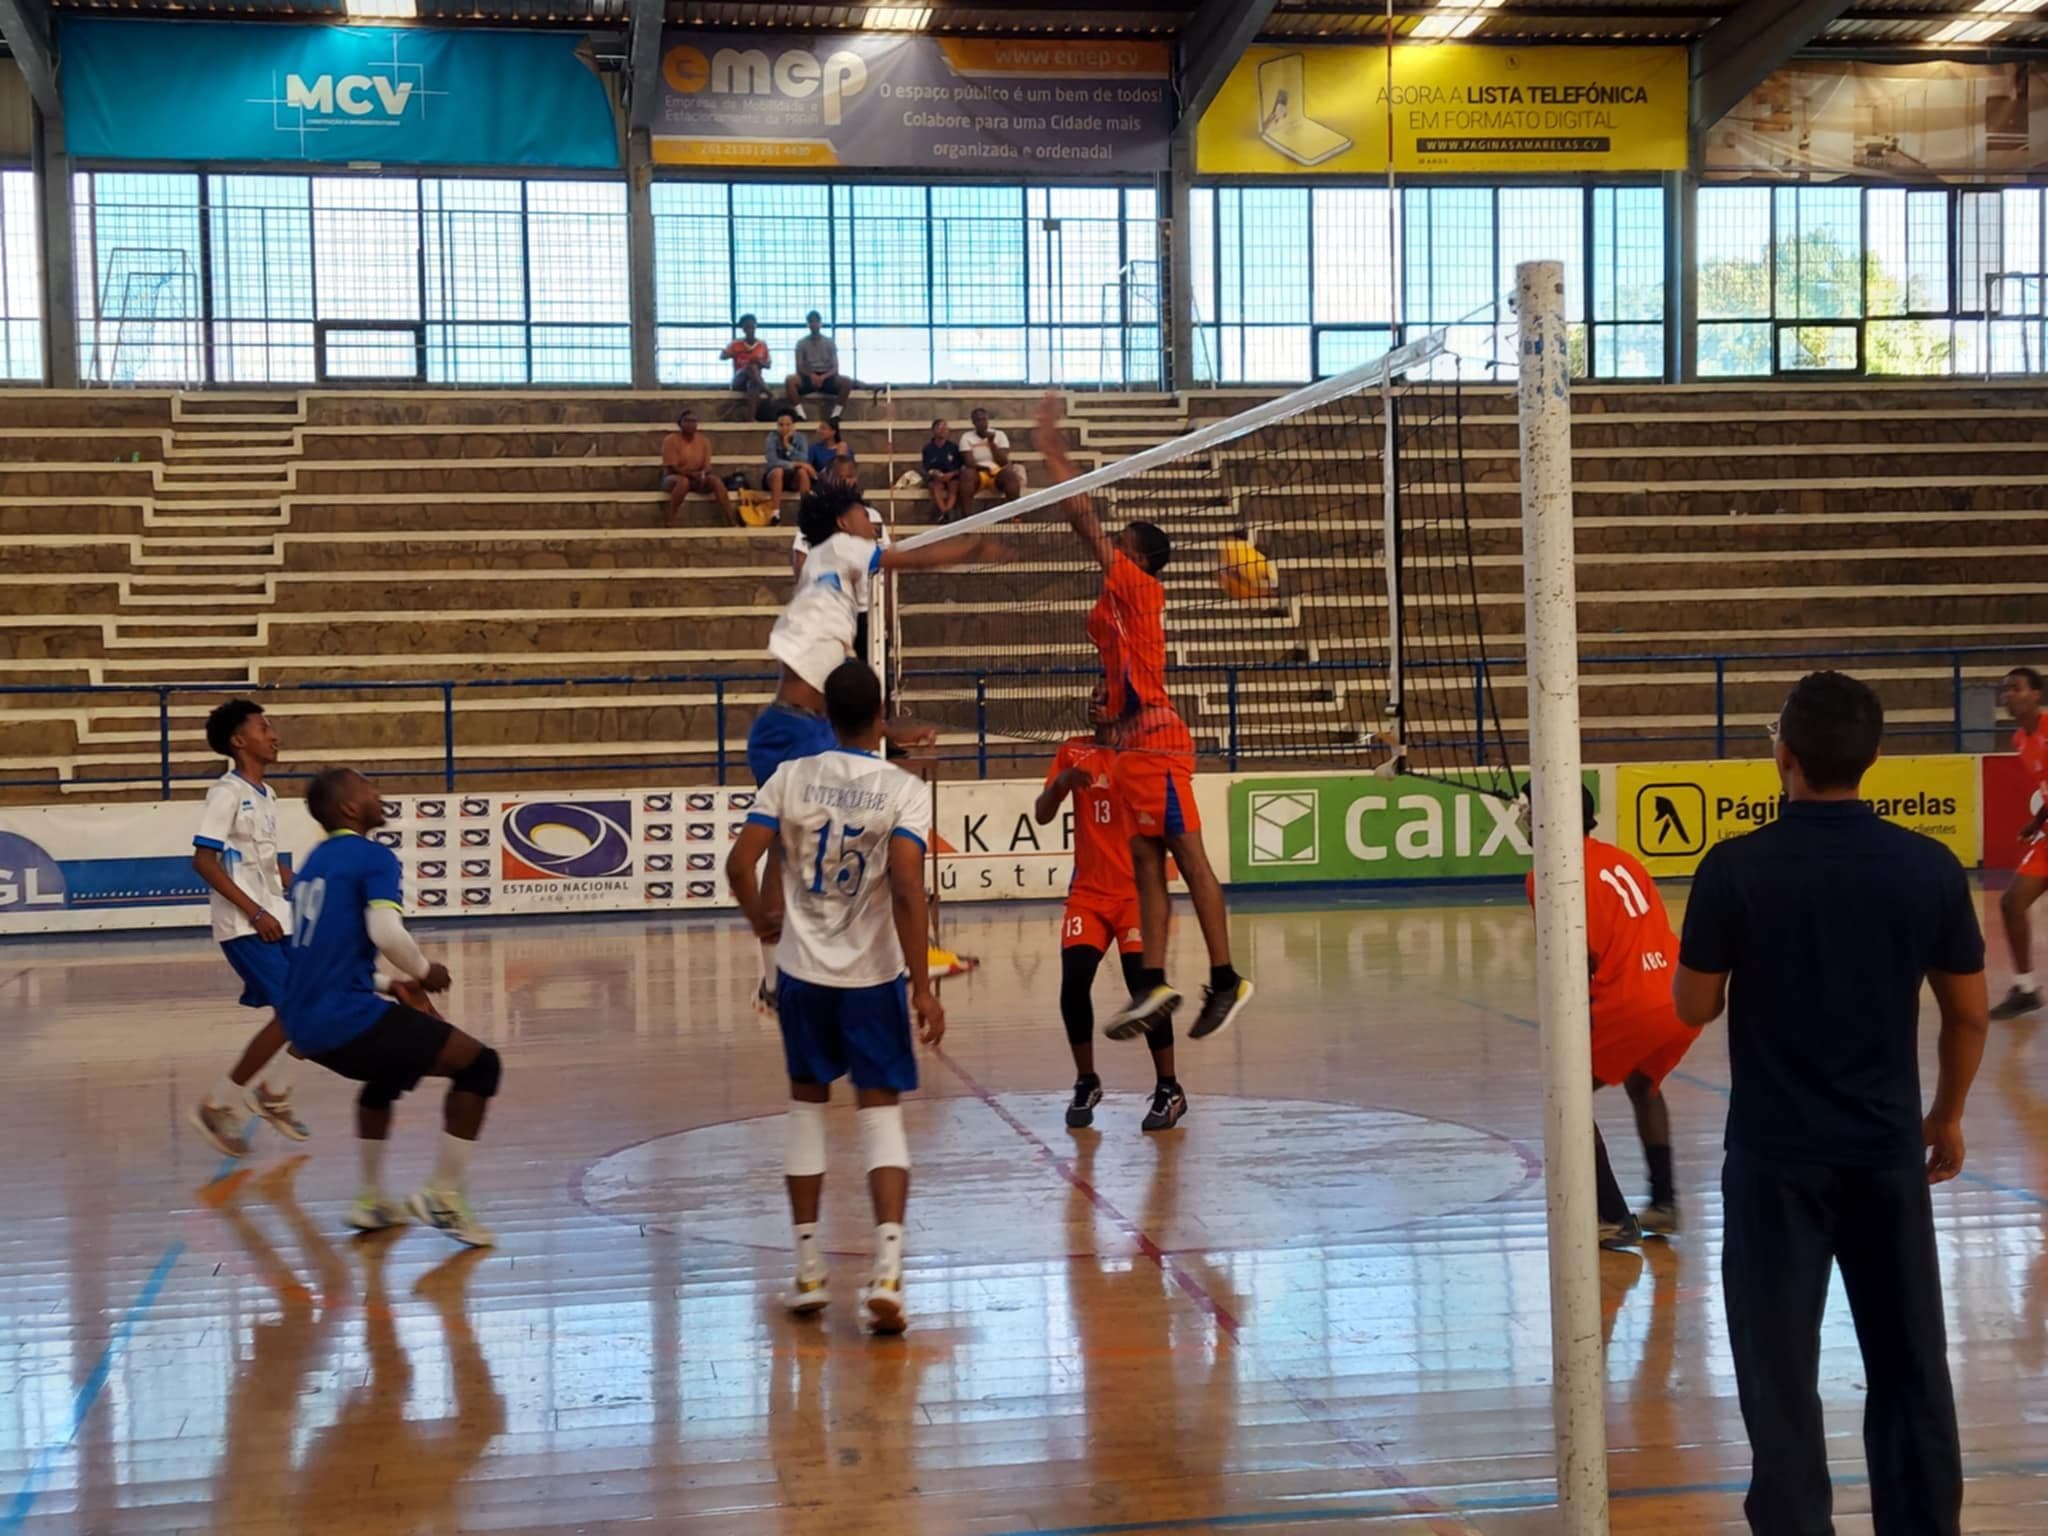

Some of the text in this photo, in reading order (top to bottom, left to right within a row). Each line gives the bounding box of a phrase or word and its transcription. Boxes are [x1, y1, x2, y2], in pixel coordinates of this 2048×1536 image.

[285, 74, 414, 115] MCV
[663, 46, 868, 125] emep
[879, 83, 1163, 103] O espaço público é um bem de todos!
[1376, 82, 1649, 104] AGORA A LISTA TELEFÓNICA
[902, 112, 1142, 136] Colabore para uma Cidade mais
[1409, 109, 1618, 129] EM FORMATO DIGITAL
[932, 142, 1018, 160] organizada
[1093, 800, 1111, 824] 13
[1716, 796, 1781, 825] Pági
[1345, 794, 1534, 860] caix
[805, 818, 866, 897] 15
[502, 881, 630, 894] ESTADIO NACIONAL
[940, 864, 1058, 889] ústr
[1599, 864, 1650, 918] 11
[1065, 915, 1083, 938] 13
